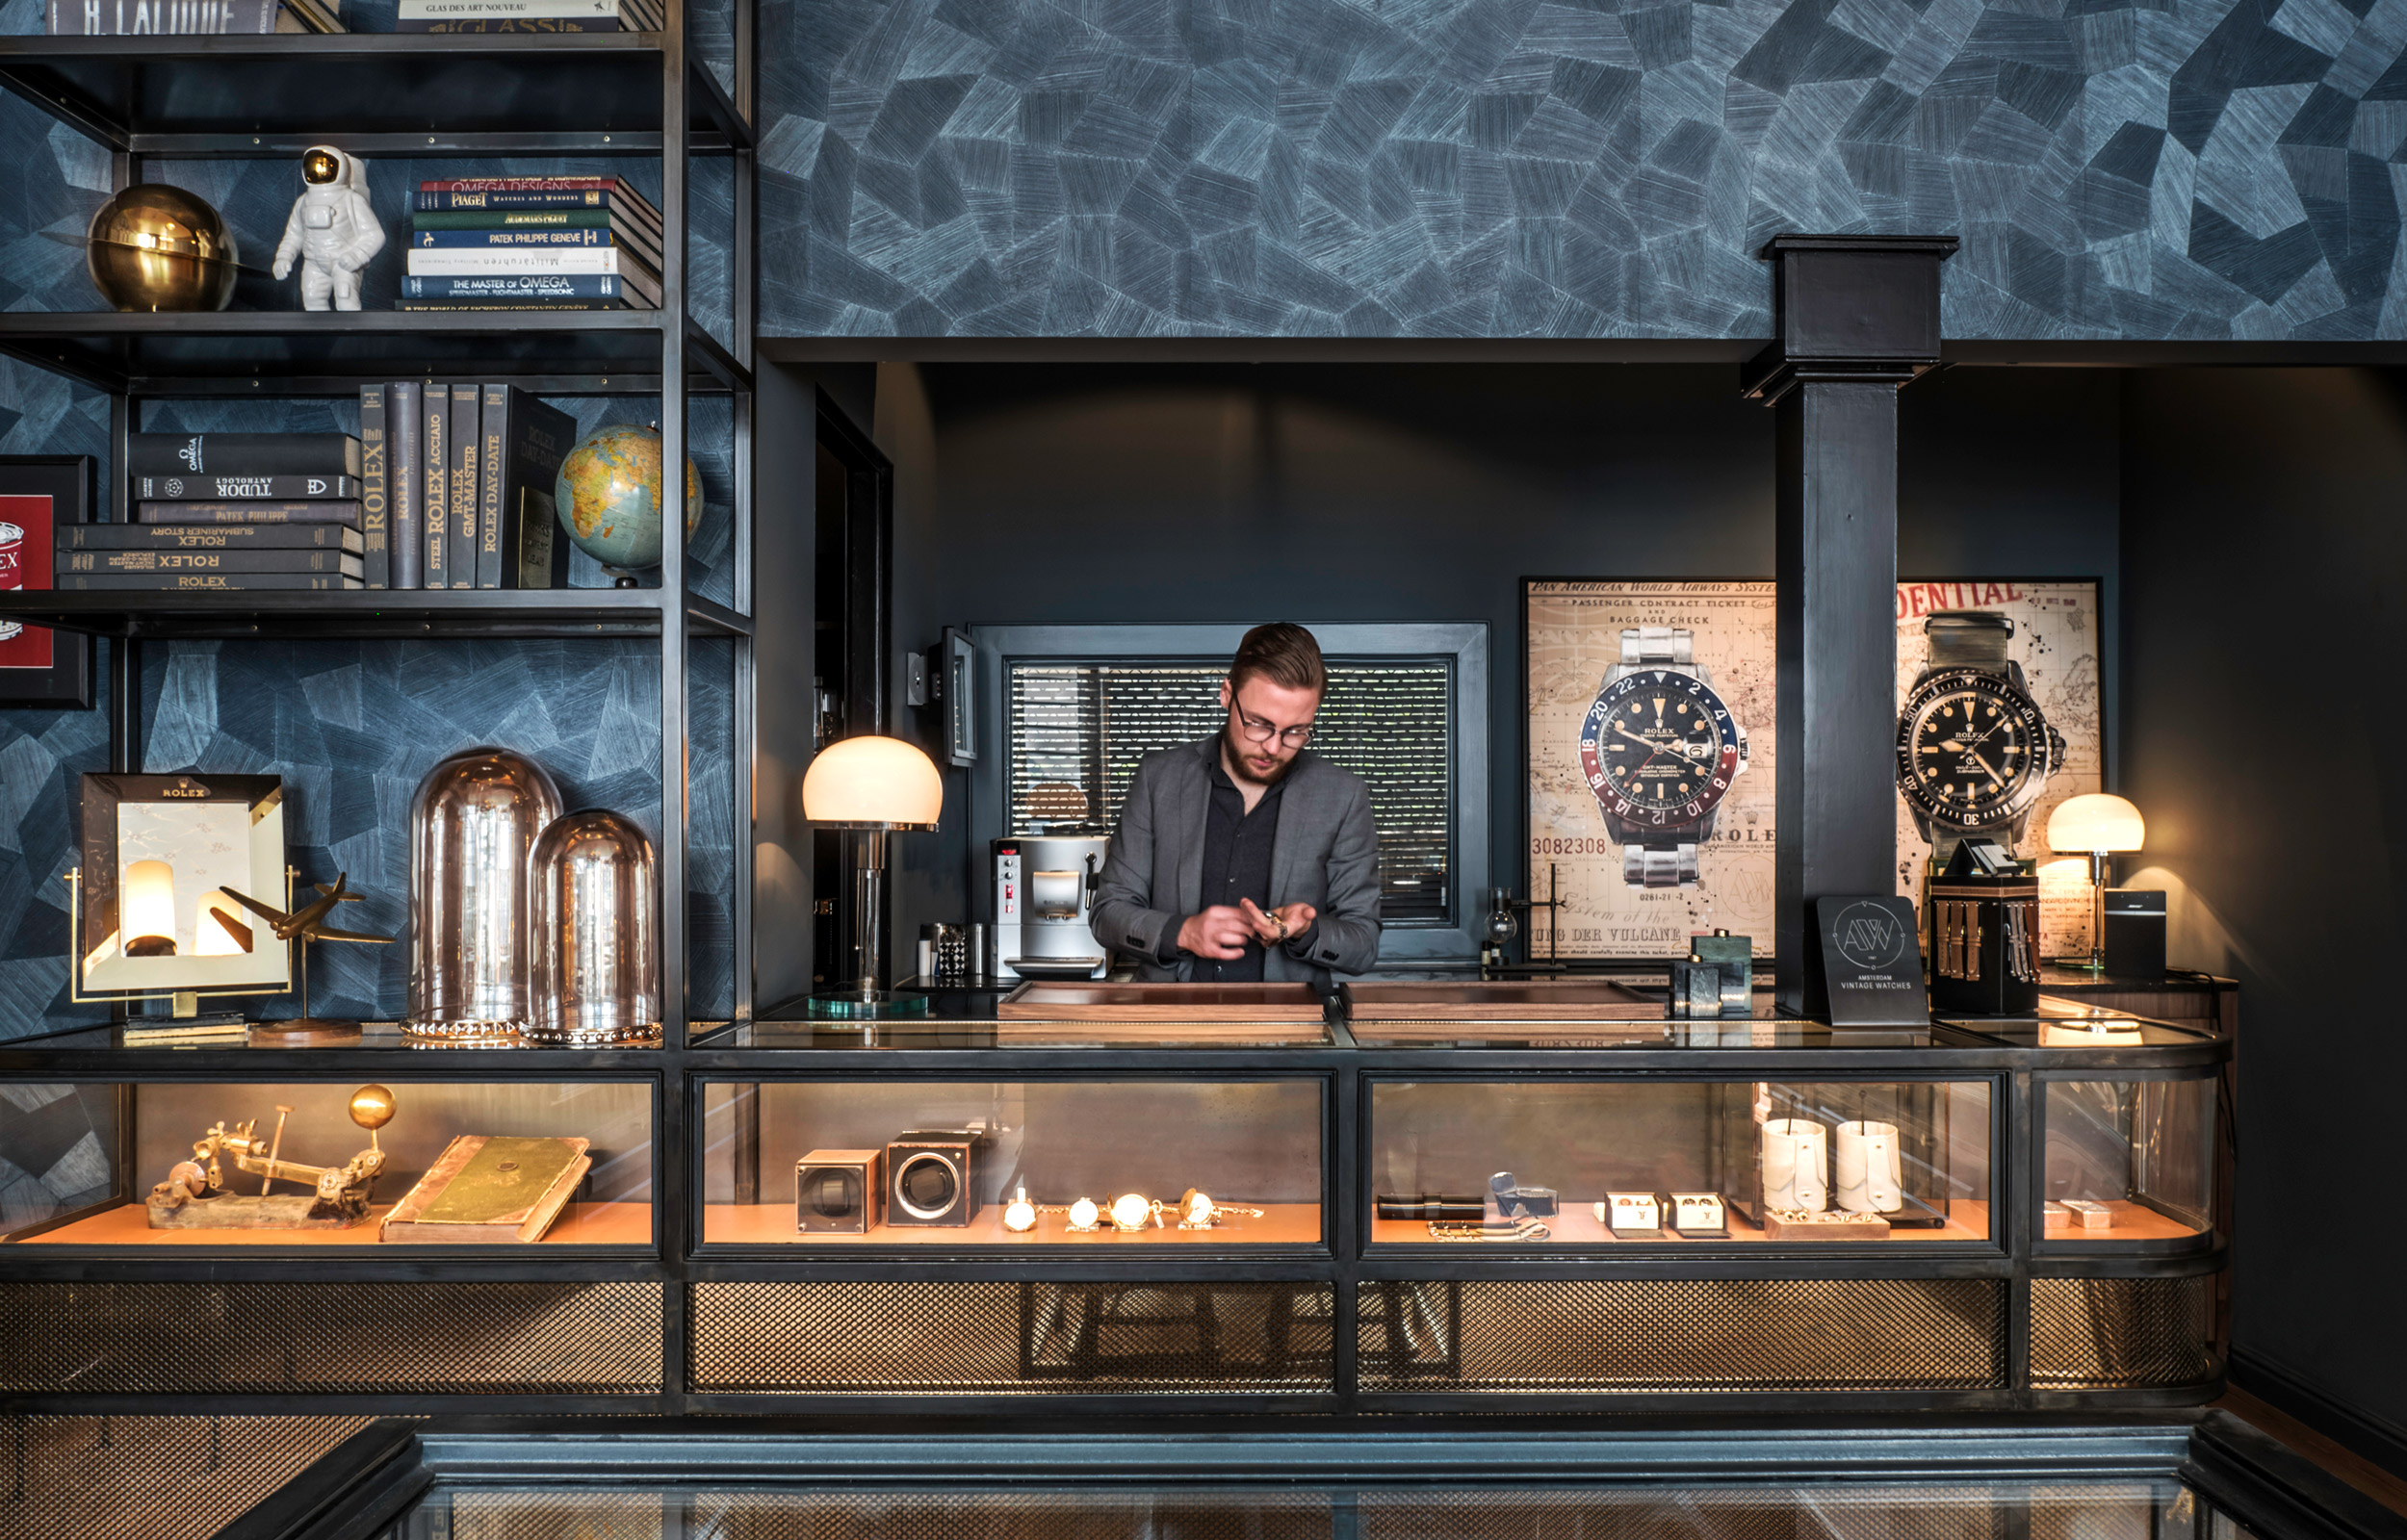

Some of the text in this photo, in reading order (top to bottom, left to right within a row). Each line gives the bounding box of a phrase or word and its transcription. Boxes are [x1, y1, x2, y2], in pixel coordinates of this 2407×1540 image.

[484, 3, 527, 12] NOUVEAU
[452, 181, 505, 192] OMEGA
[451, 192, 488, 207] PIAGET
[489, 234, 514, 244] PATEK
[515, 233, 549, 244] PHILIPPE
[551, 233, 581, 243] GENEVE
[483, 257, 559, 267] Militäruhren
[453, 280, 470, 289] THE
[471, 280, 505, 289] MASTER
[519, 276, 569, 289] OMEGA
[189, 437, 198, 472] OMEGA
[216, 484, 272, 497] TUDOR
[364, 443, 385, 530] ROLEX
[398, 466, 409, 520] ROLEX
[428, 414, 444, 570] STEEL ROLEX ACCIAIO
[453, 470, 463, 515] ROLEX
[464, 446, 476, 538] GMT-MASTER
[484, 435, 500, 552] ROLEX DAY-DATE
[216, 510, 288, 523] PATEK PHILIPPE
[150, 527, 185, 536] STORY
[178, 536, 226, 546] ROLEX
[160, 555, 220, 567] ROLEX
[178, 578, 226, 586] ROLEX
[1531, 581, 1559, 592] PAN
[1560, 581, 1625, 592] AMERICAN
[1630, 582, 1673, 592] WORLD
[1676, 582, 1732, 592] AIRWAYS
[1616, 677, 1636, 696] 22
[1688, 682, 1701, 696] 2
[1590, 701, 1609, 721] 20
[1713, 708, 1728, 721] 4
[1903, 706, 1919, 723] 50
[1581, 738, 1596, 752] 18
[1590, 772, 1607, 790] 16
[1713, 778, 1727, 790] 8
[1904, 775, 1919, 791] 40
[162, 789, 205, 798] ROLEX
[1615, 797, 1632, 816] 14
[1686, 800, 1703, 817] 10
[1651, 810, 1667, 825] 12
[1963, 813, 1980, 826] 30
[1532, 837, 1606, 855] 3082308
[1571, 928, 1603, 942] DER
[1607, 926, 1681, 942] VULCANE
